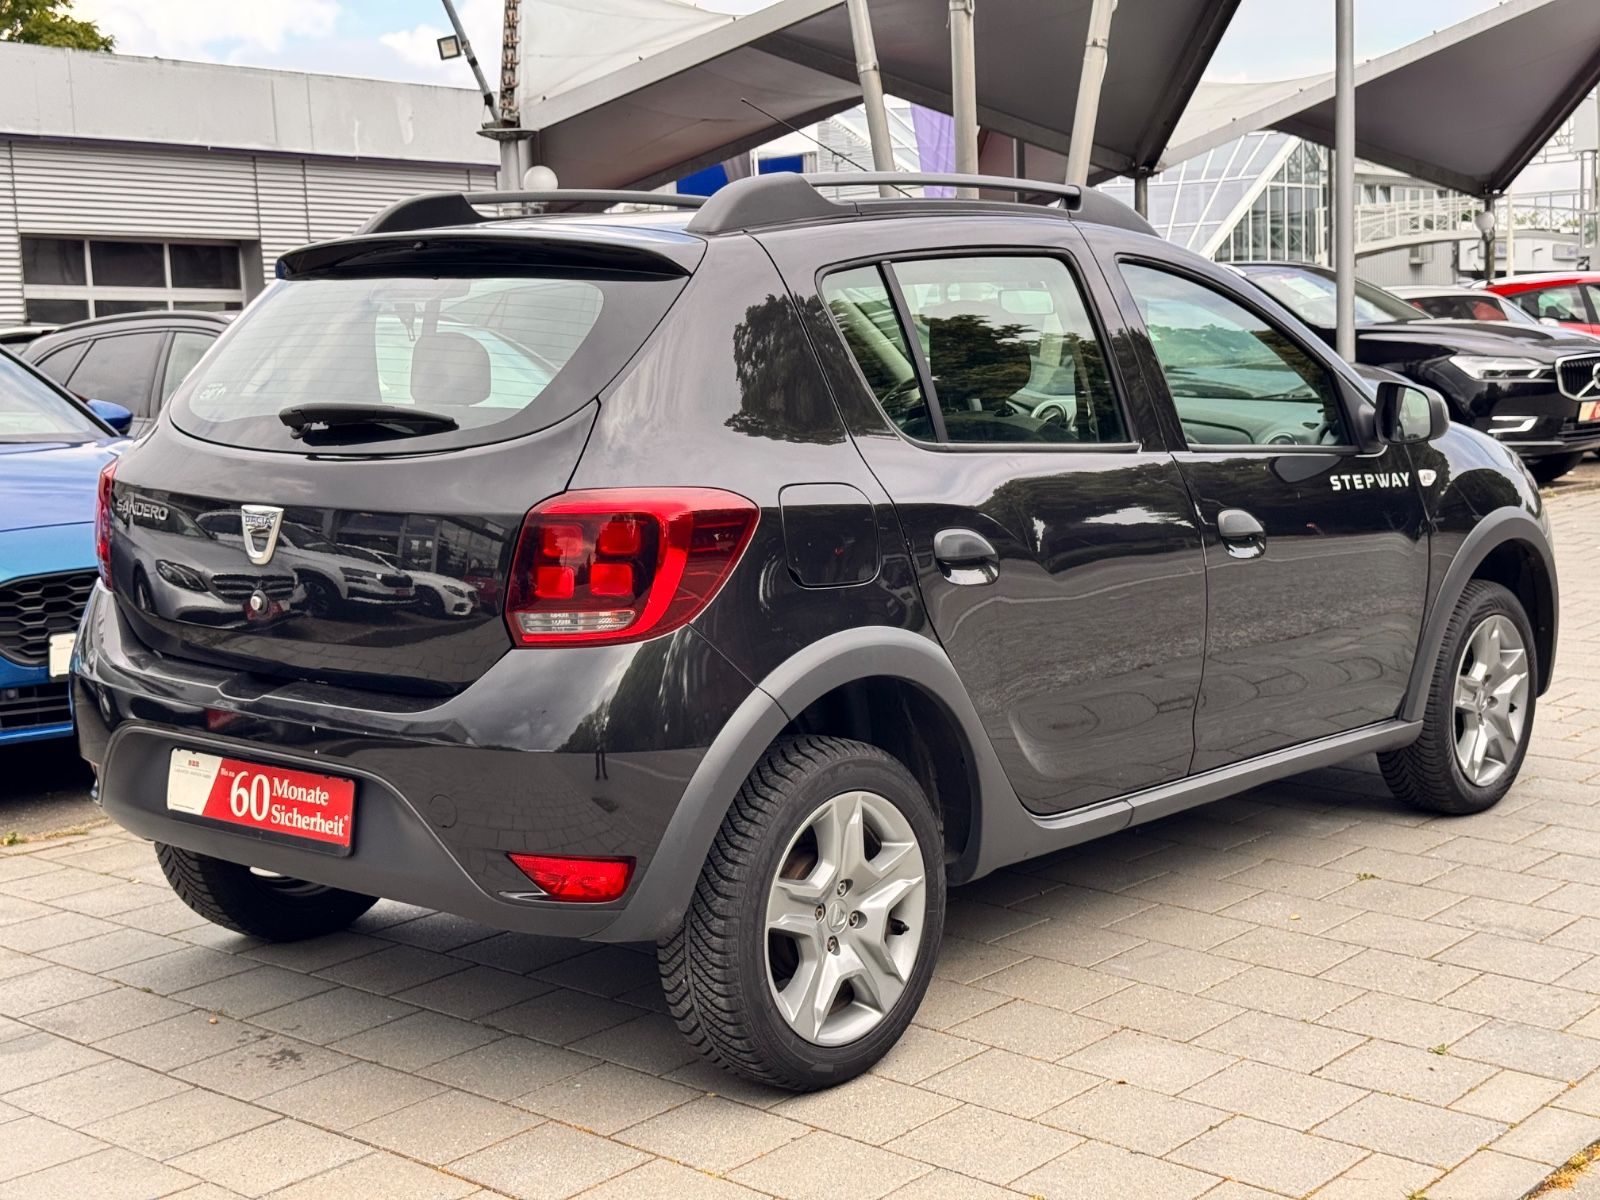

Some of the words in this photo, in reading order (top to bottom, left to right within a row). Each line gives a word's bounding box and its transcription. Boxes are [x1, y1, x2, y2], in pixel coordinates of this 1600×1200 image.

[1330, 472, 1410, 491] STEPWAY
[116, 499, 169, 521] SANDERO
[245, 515, 272, 525] DACIA
[230, 771, 270, 821] 60
[272, 777, 330, 806] Monate
